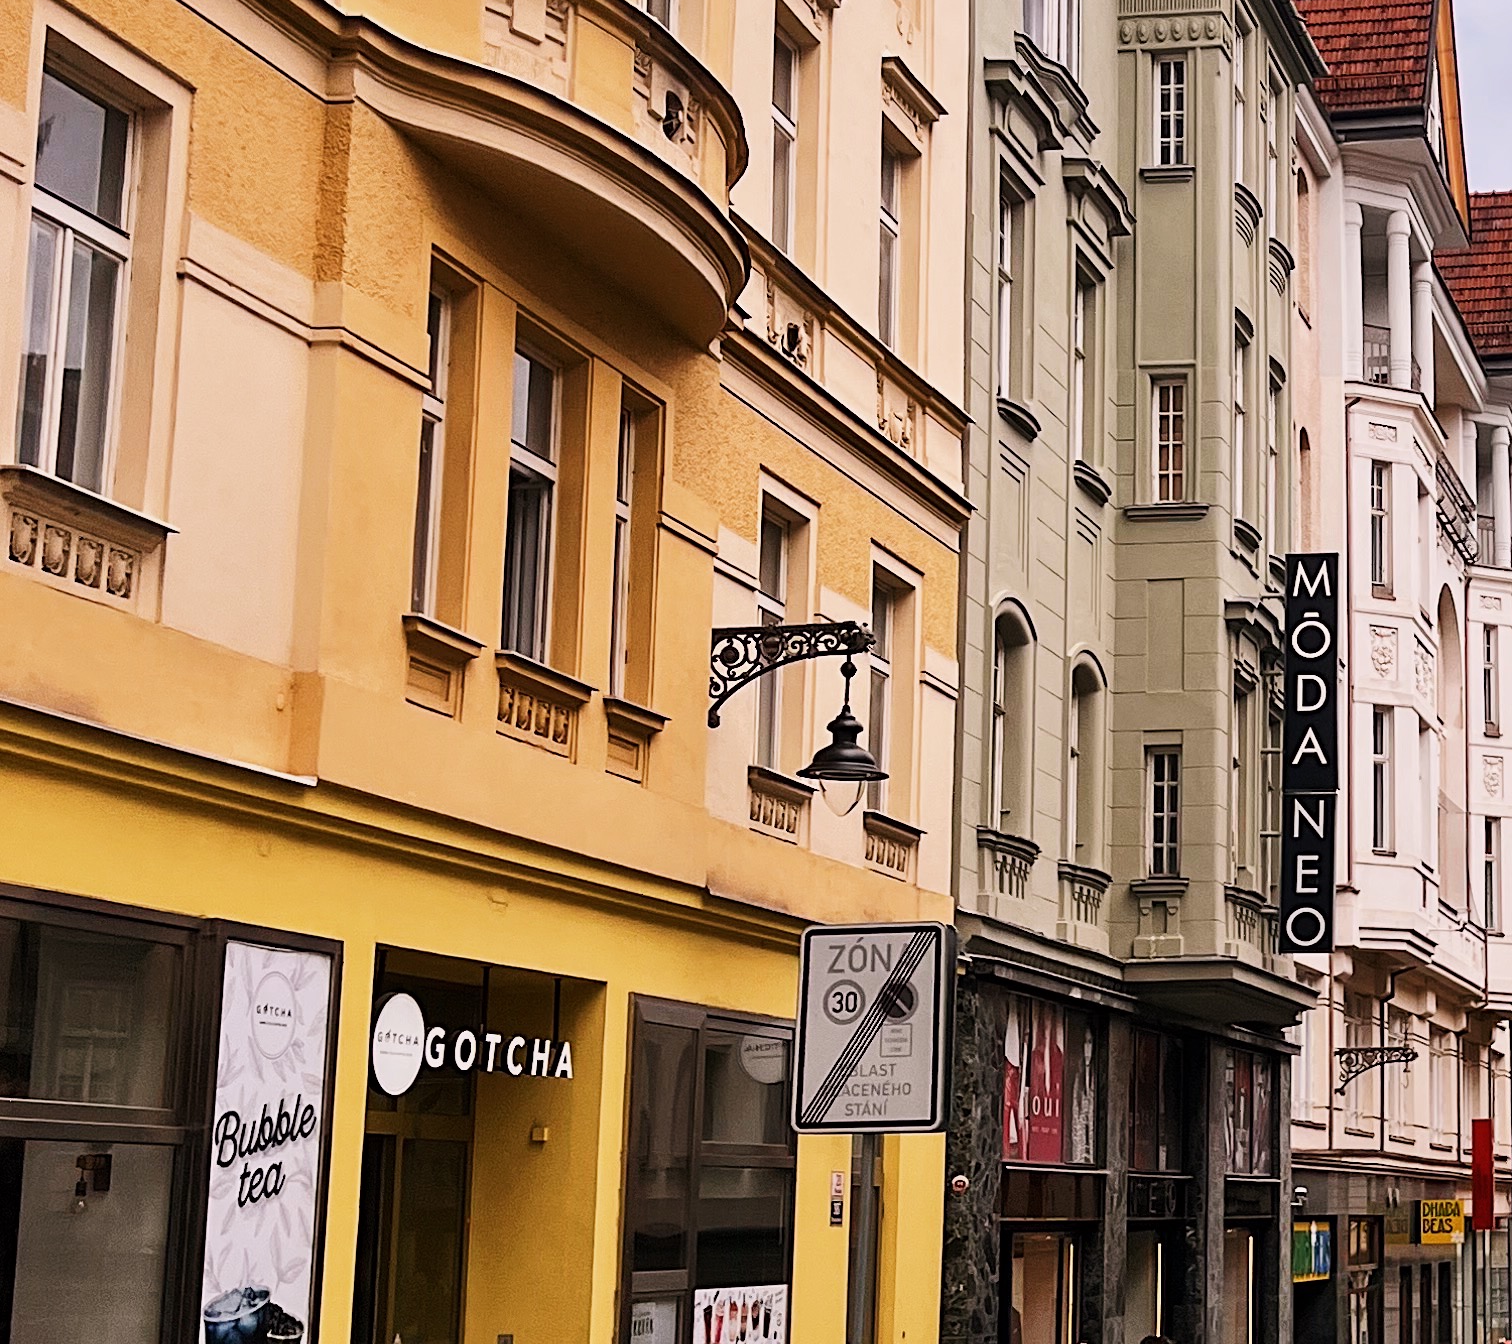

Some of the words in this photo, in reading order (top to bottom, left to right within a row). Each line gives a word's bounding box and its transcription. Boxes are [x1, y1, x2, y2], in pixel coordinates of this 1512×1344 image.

[1286, 798, 1326, 948] NEO
[827, 937, 911, 974] ZÓN
[831, 991, 858, 1014] 30
[425, 1026, 574, 1079] GOTCHA
[846, 1063, 897, 1078] BLAST
[832, 1080, 912, 1097] ACENÉHO
[844, 1099, 889, 1117] STÁNÍ
[215, 1094, 317, 1168] Bubble
[237, 1160, 286, 1209] tea
[1422, 1218, 1453, 1234] BEAS
